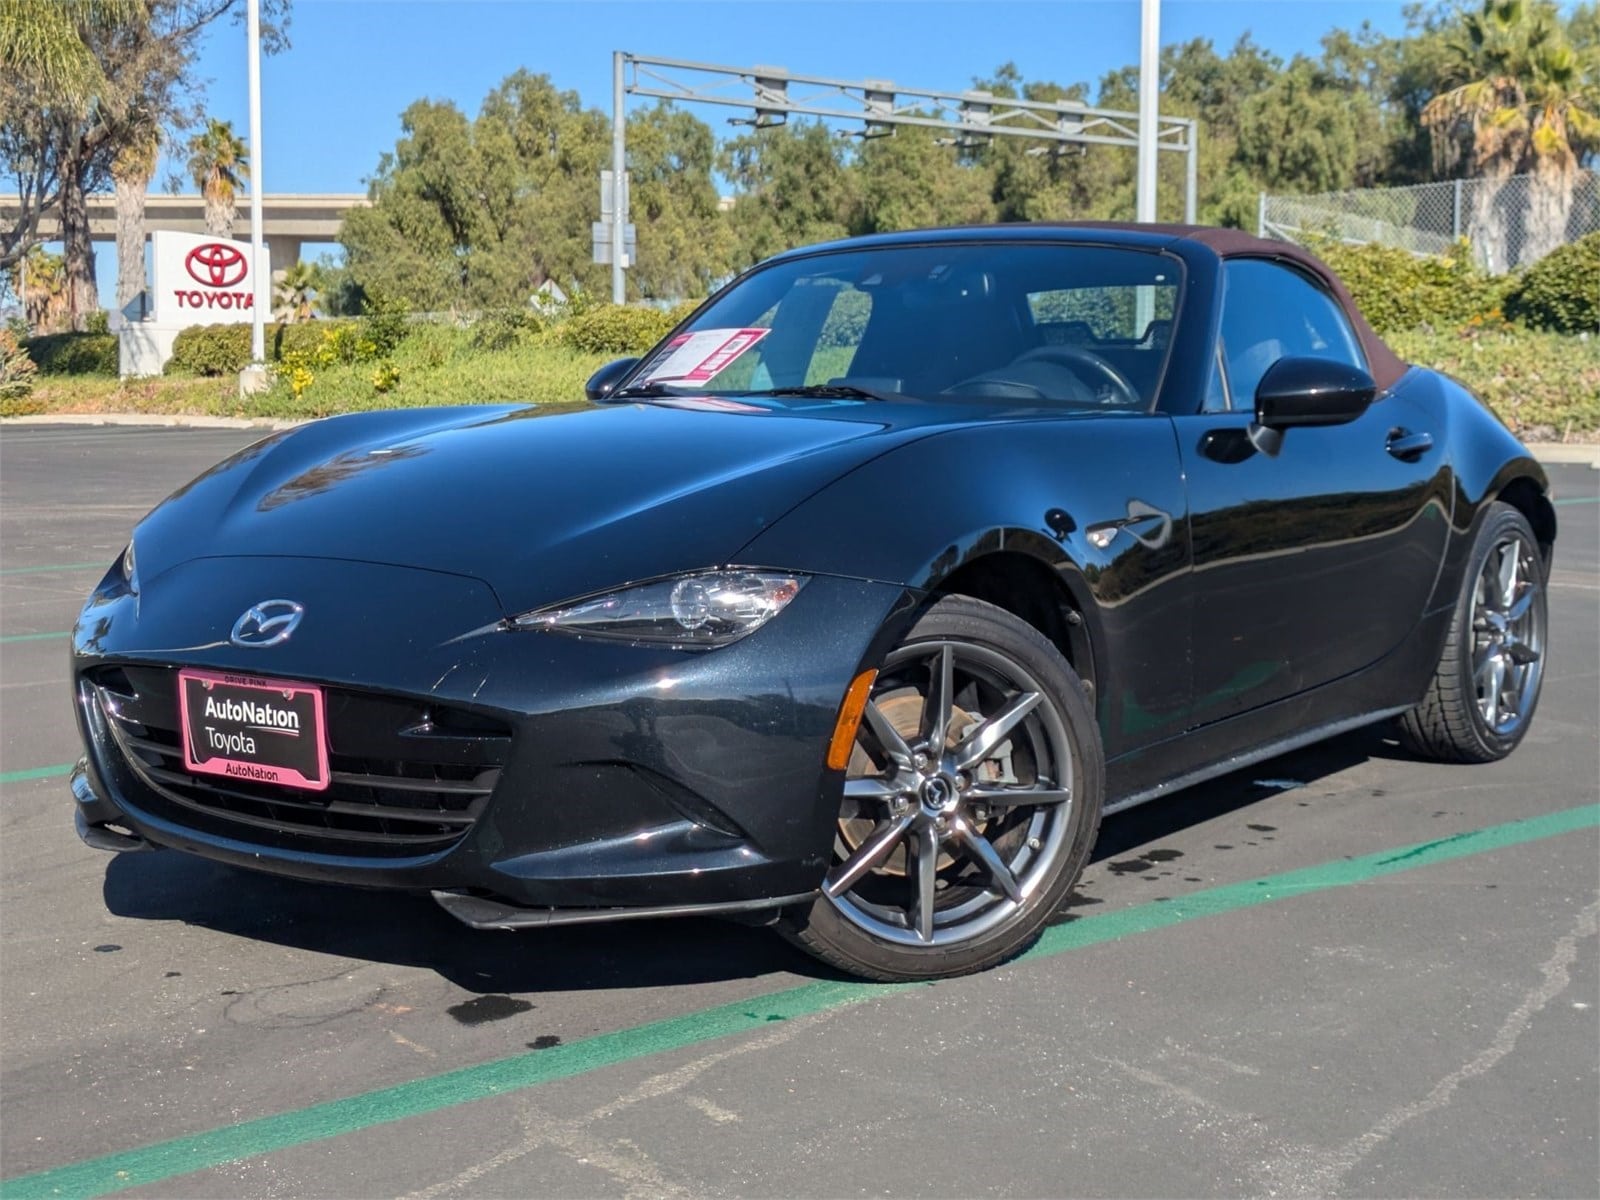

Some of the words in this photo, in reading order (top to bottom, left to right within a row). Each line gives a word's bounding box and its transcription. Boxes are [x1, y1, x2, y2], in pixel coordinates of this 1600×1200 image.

[174, 290, 254, 310] TOYOTA
[224, 675, 247, 685] DRIVE
[248, 678, 267, 687] PINK
[205, 696, 299, 728] AutoNation
[205, 726, 255, 755] Toyota
[225, 763, 279, 781] AutoNation
